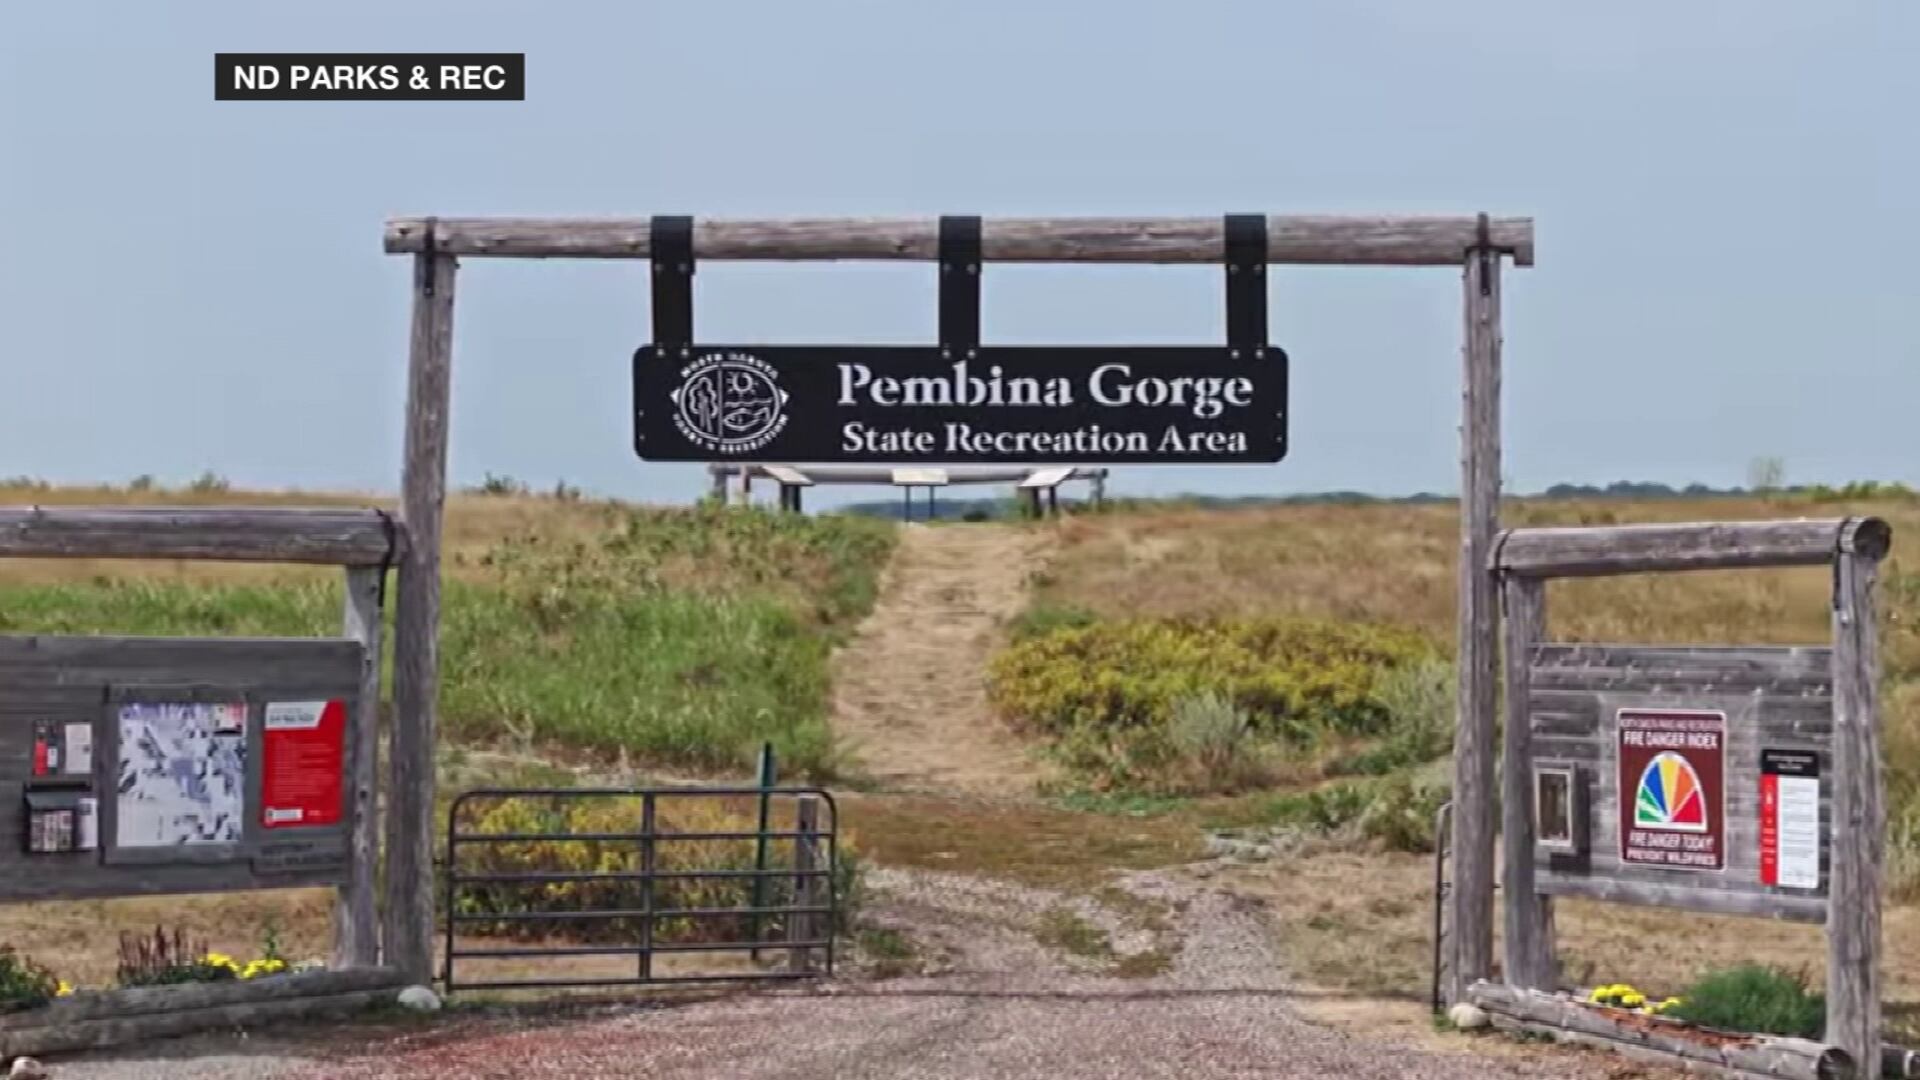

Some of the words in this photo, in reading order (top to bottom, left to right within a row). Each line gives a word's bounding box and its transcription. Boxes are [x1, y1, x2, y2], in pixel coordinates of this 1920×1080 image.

[837, 362, 1074, 407] Pembina
[1089, 364, 1254, 417] Gorge
[842, 422, 935, 452] State
[945, 423, 1149, 453] Recreation
[1158, 425, 1248, 452] Area
[1623, 731, 1645, 746] FIRE
[1647, 732, 1685, 747] DANGER
[1687, 734, 1718, 749] INDEX
